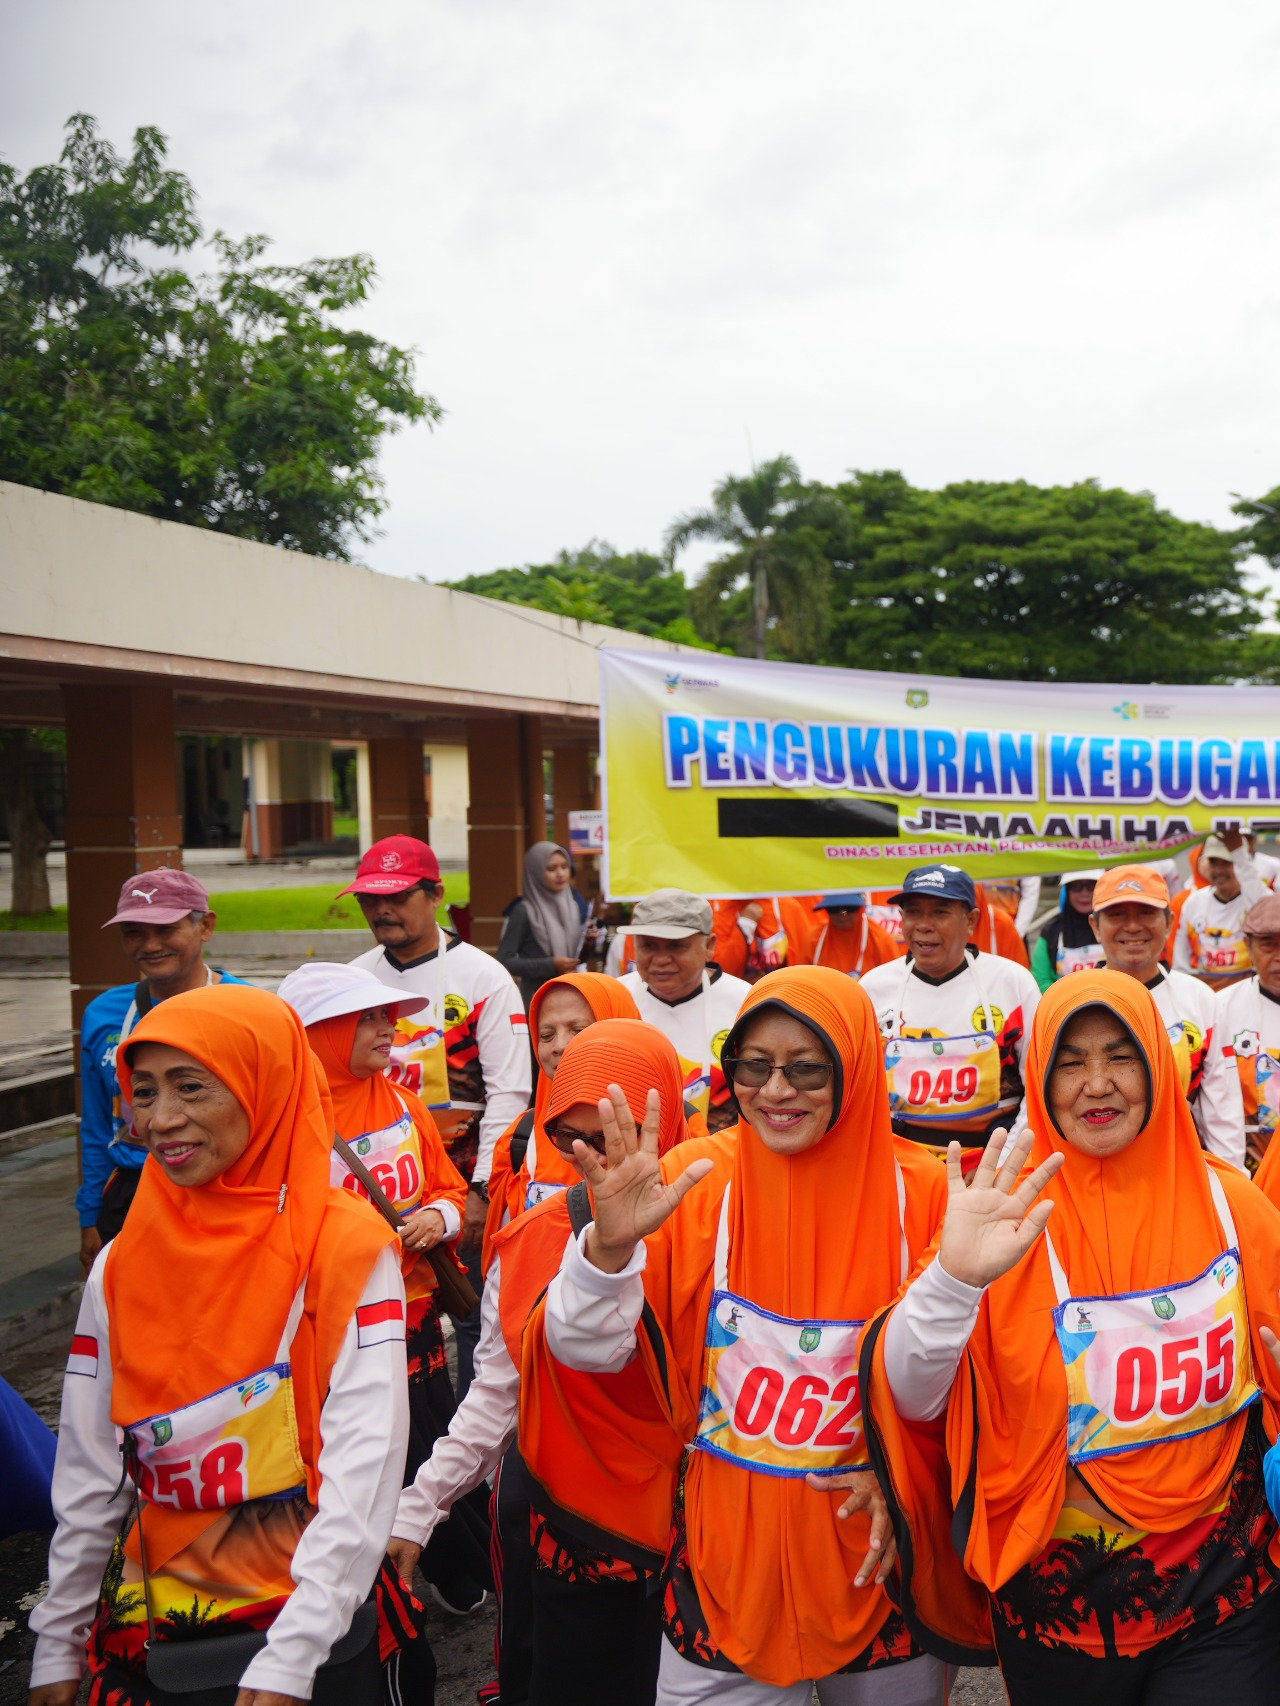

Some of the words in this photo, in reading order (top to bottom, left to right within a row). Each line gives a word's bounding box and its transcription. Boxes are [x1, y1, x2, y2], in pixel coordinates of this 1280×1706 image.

[667, 716, 1036, 796] PENGUKURAN
[827, 846, 881, 858] DINAS
[902, 811, 1111, 840] JEMAAH
[908, 1067, 977, 1105] 049
[1113, 1316, 1233, 1421] 055
[733, 1366, 861, 1446] 062
